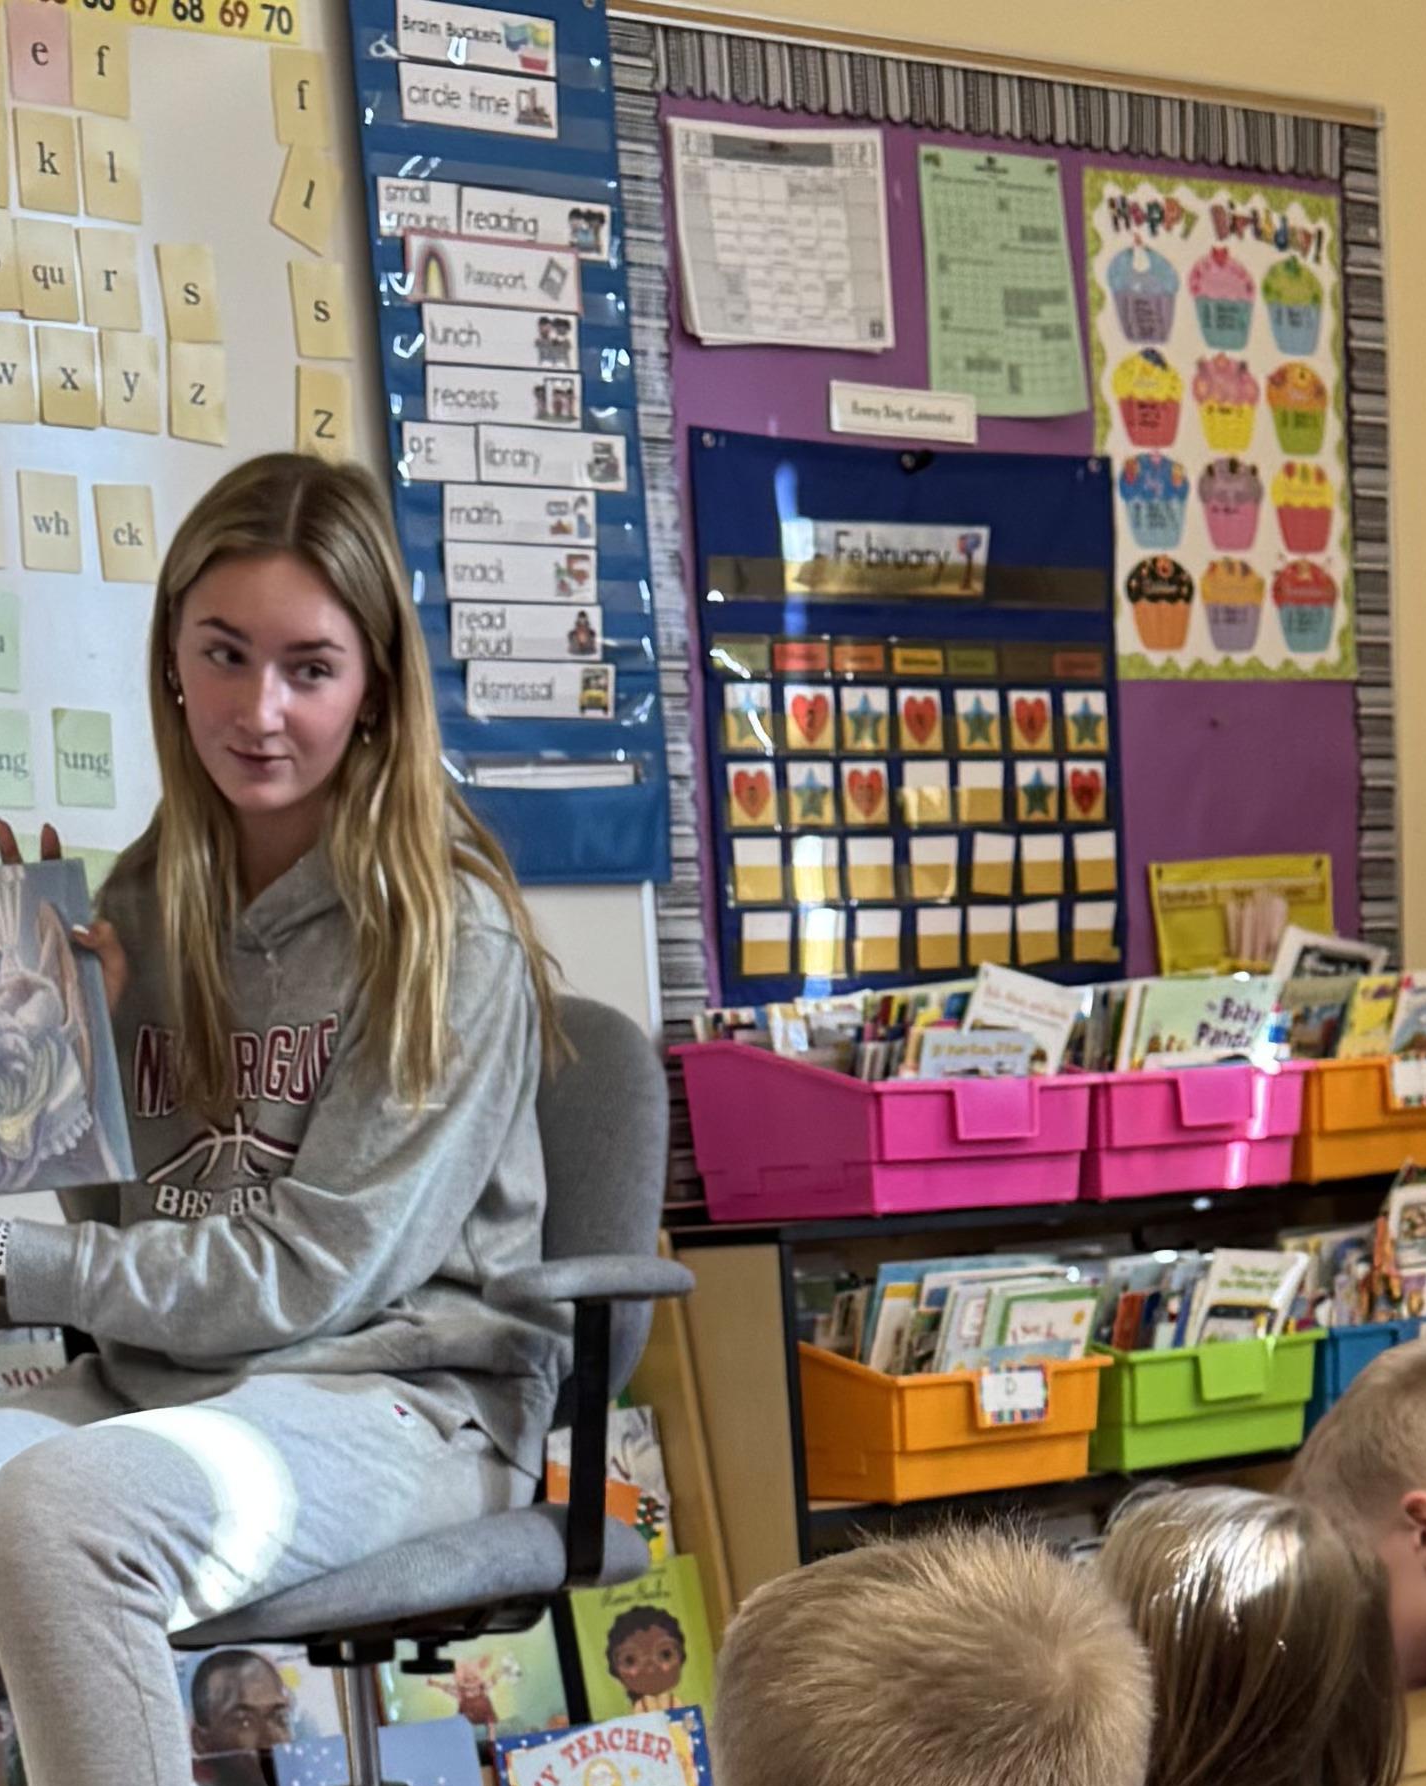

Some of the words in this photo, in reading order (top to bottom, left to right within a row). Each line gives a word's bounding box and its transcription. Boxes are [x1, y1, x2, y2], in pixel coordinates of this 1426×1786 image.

[173, 0, 205, 23] 68
[219, 0, 249, 29] 69
[259, 4, 292, 35] 70
[31, 42, 49, 66] e
[96, 44, 110, 77] f
[297, 79, 310, 111] f
[407, 82, 462, 109] circle
[468, 87, 511, 115] time
[37, 141, 60, 176] k
[385, 209, 450, 230] roups
[466, 208, 539, 243] reading
[31, 264, 65, 291] qu
[103, 269, 118, 292] r
[183, 282, 201, 306] s
[313, 300, 331, 323] s
[429, 316, 481, 346] lunch
[60, 366, 80, 391] x
[122, 370, 140, 403] y
[190, 382, 206, 406] z
[433, 384, 500, 412] recess
[482, 440, 542, 476] library
[32, 510, 70, 537] wh
[113, 521, 143, 546] ck
[449, 500, 503, 527] math
[834, 529, 952, 584] February
[452, 561, 505, 585] snack
[456, 607, 507, 631] read
[456, 635, 513, 659] aloud
[472, 676, 556, 702] dismissal
[61, 751, 111, 778] ung
[560, 1727, 673, 1771] TEACHER
